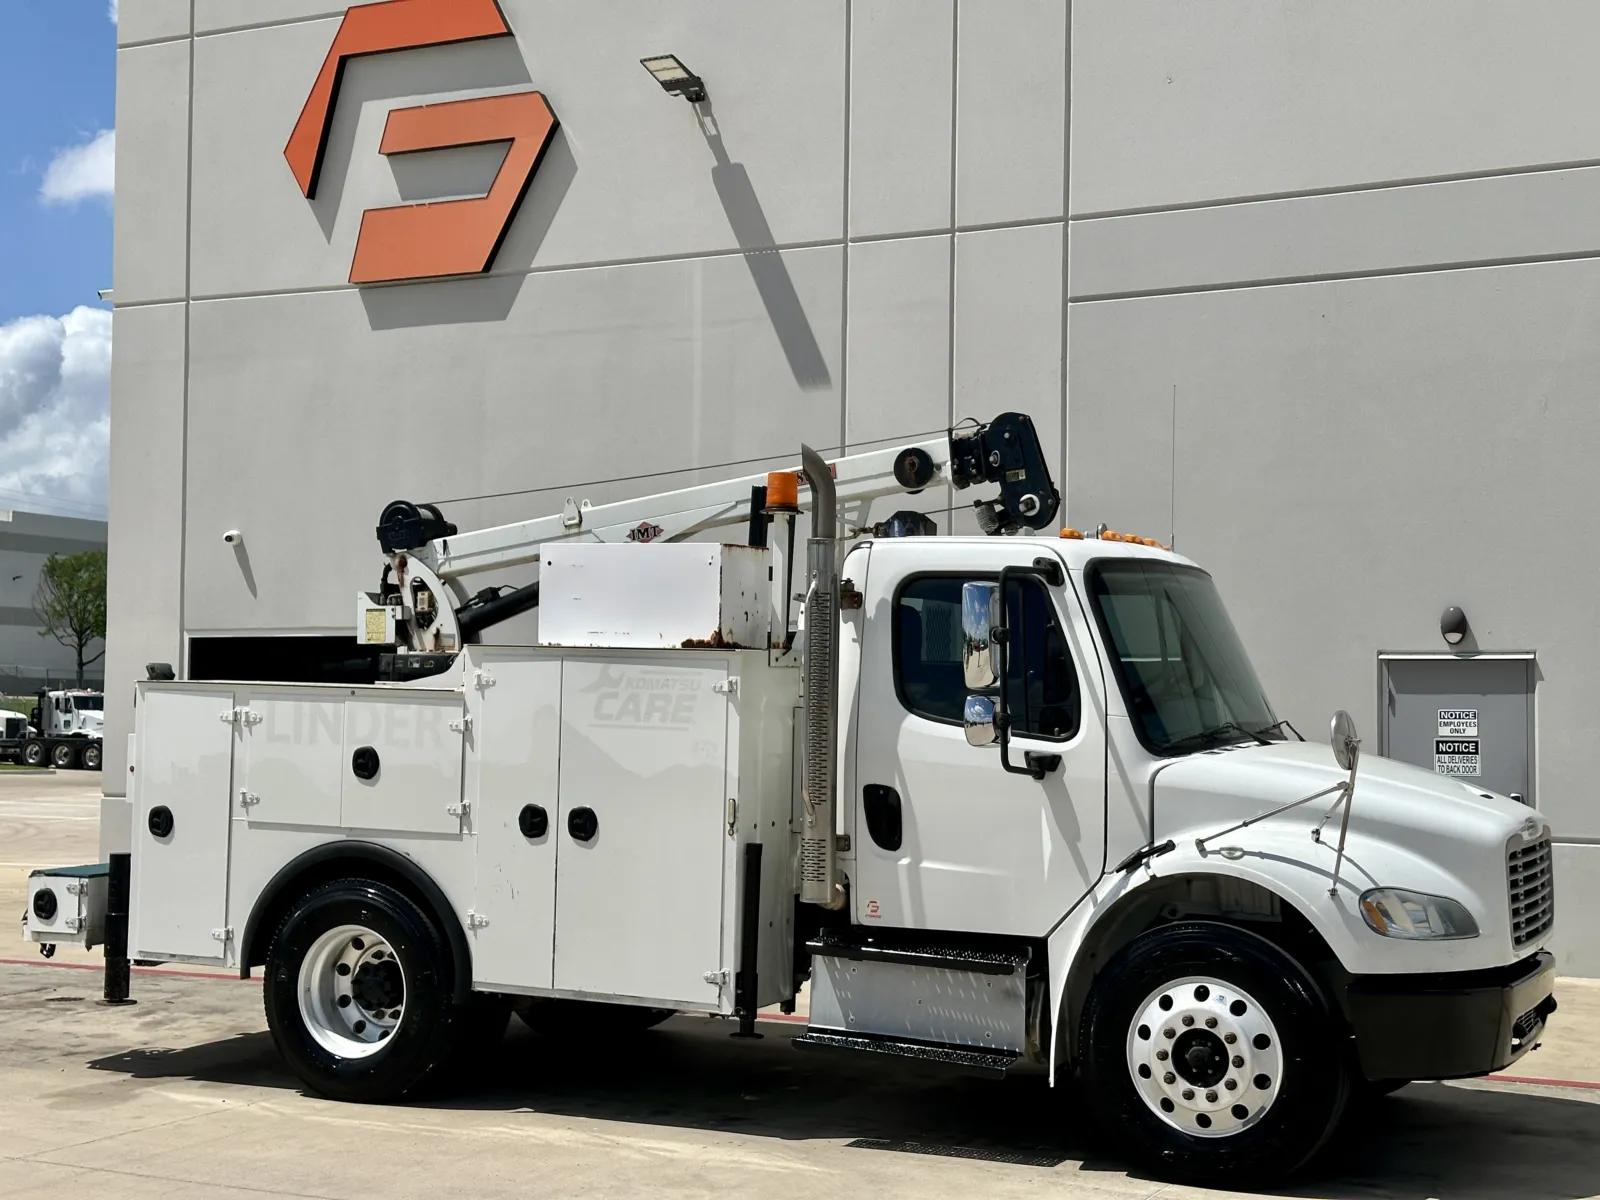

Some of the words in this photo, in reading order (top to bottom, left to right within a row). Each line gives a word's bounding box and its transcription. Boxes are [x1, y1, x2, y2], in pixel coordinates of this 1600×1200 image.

[630, 525, 660, 541] IMT
[593, 691, 698, 723] CARE
[1441, 711, 1475, 719] NOTICE
[265, 702, 445, 747] LINDER
[1439, 743, 1476, 752] NOTICE
[1437, 756, 1447, 764] ALL
[1448, 756, 1477, 764] DELIVERIES
[1438, 765, 1445, 773] TO
[1446, 765, 1460, 773] BACK
[1462, 765, 1477, 773] DOOR
